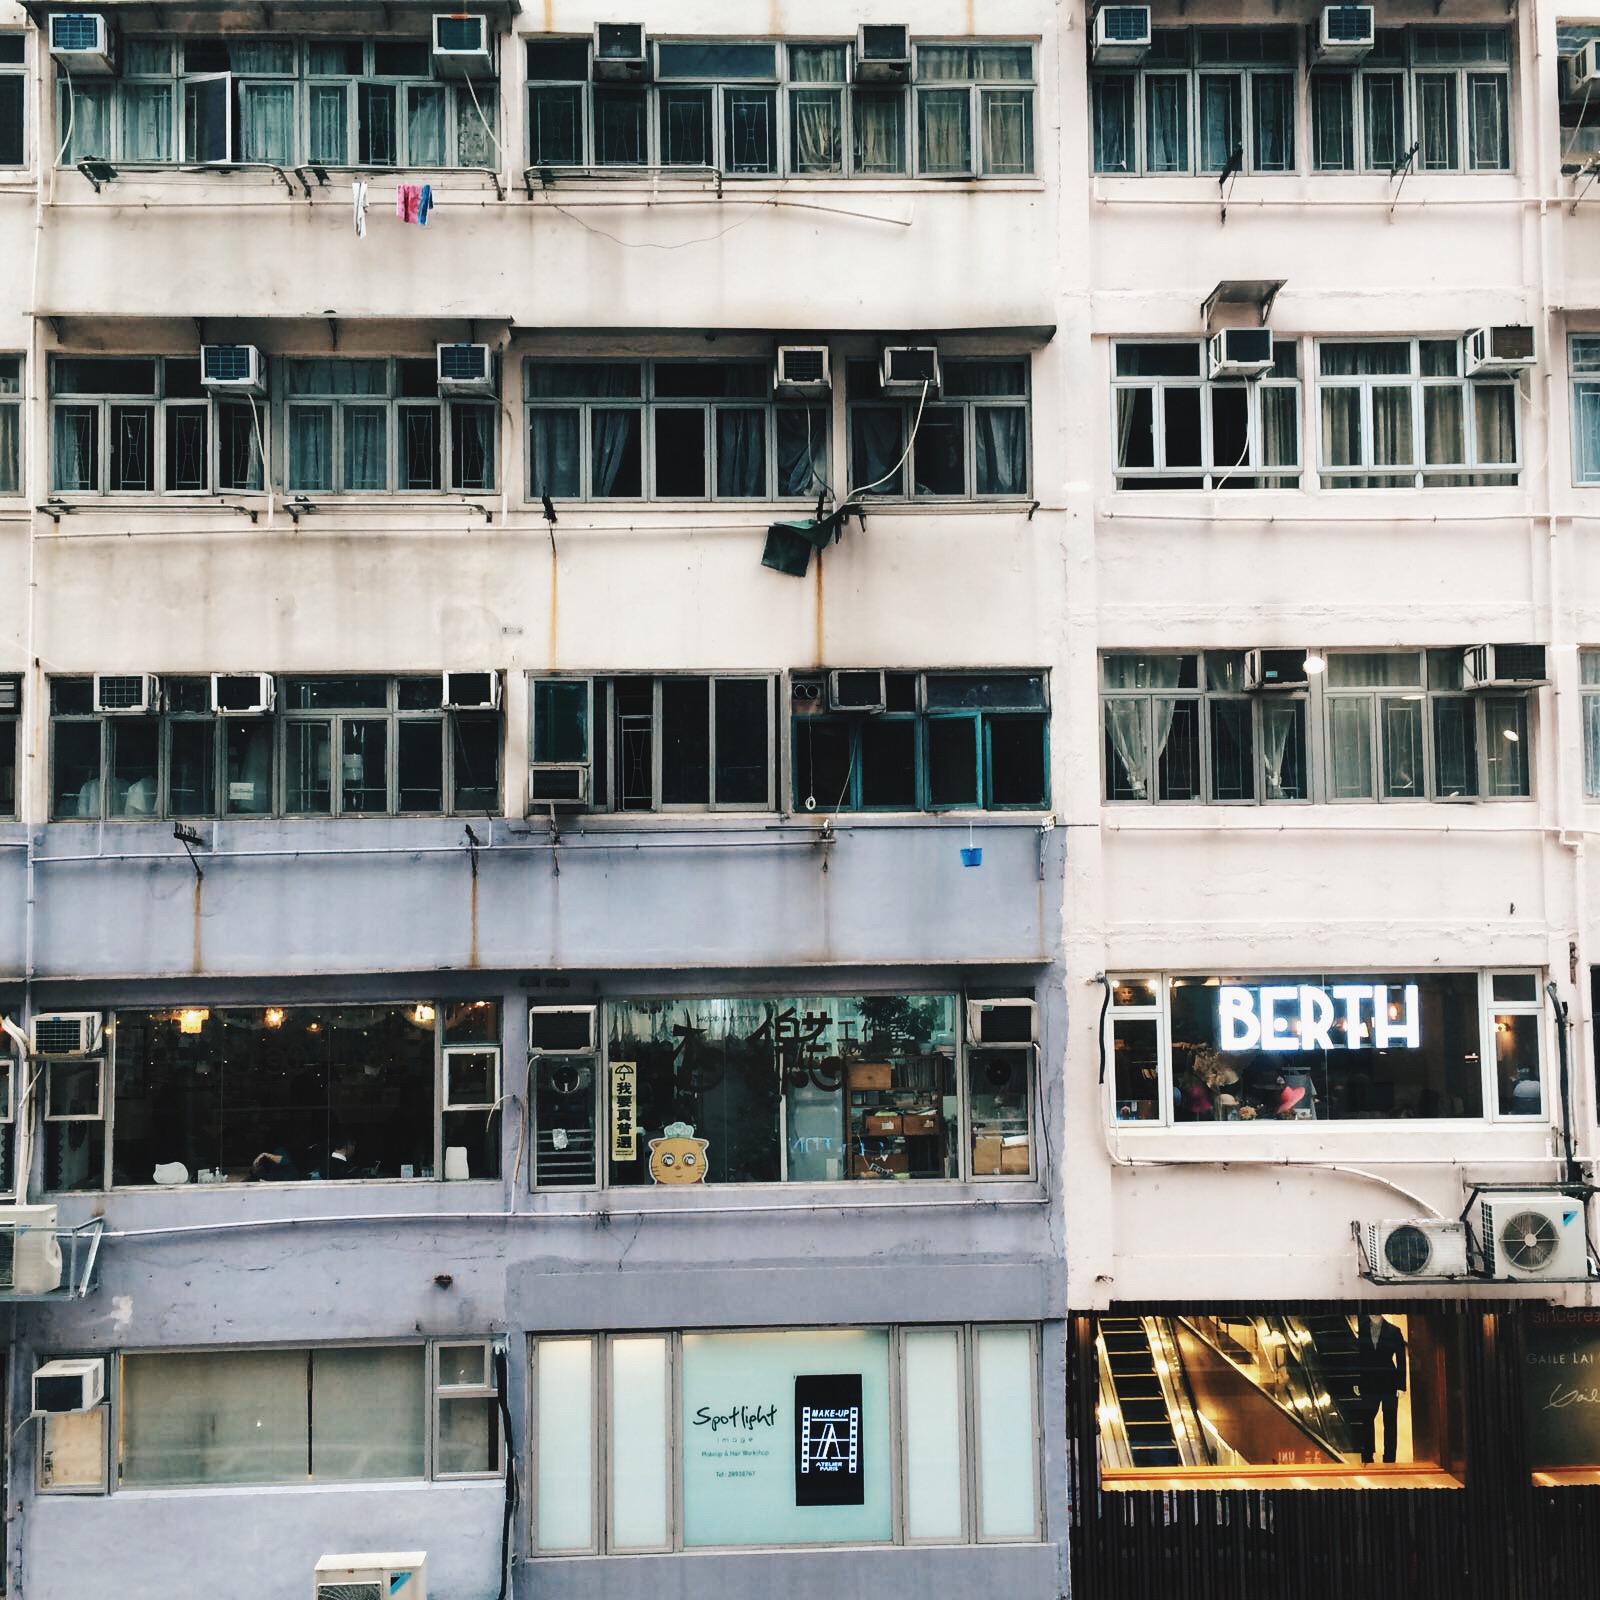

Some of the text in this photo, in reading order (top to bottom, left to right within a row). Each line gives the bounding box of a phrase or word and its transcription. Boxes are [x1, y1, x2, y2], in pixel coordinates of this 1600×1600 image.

[1219, 984, 1420, 1051] BERTH
[616, 1081, 633, 1149] 我要真普選
[1526, 1352, 1566, 1365] GAILE
[1573, 1351, 1594, 1365] LAI
[693, 1404, 778, 1431] Spotlight
[811, 1409, 850, 1418] MAKE-UP
